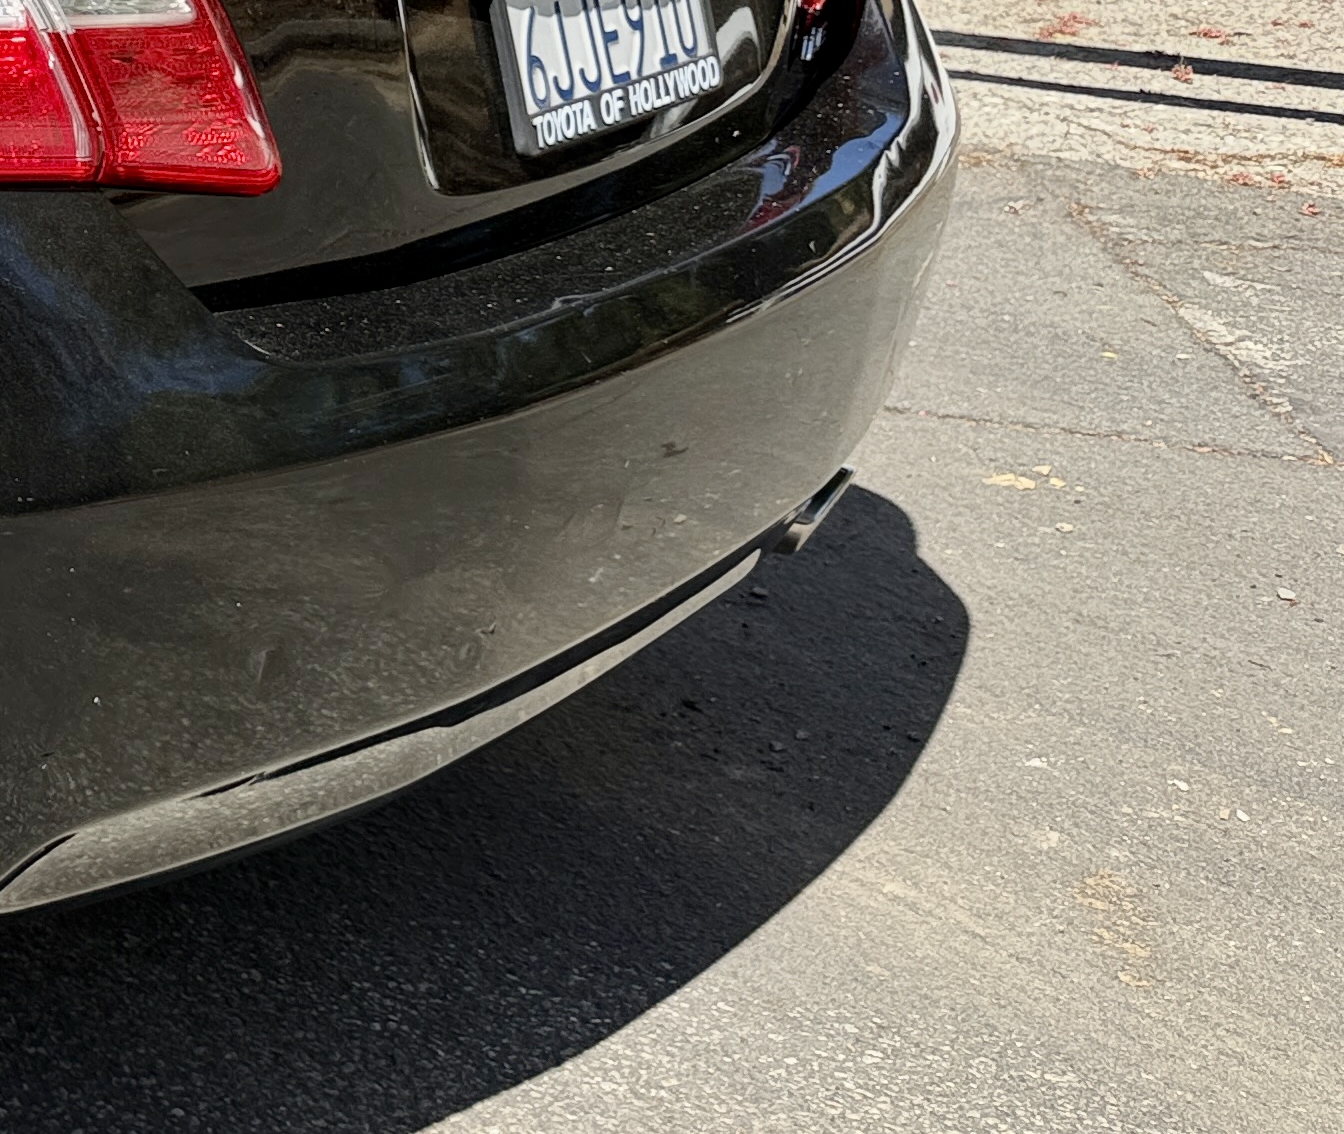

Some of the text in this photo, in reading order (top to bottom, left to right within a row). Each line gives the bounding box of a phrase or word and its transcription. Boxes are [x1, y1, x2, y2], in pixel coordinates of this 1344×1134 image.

[532, 56, 721, 148] TOYOTA OF HOLLYWOOD
